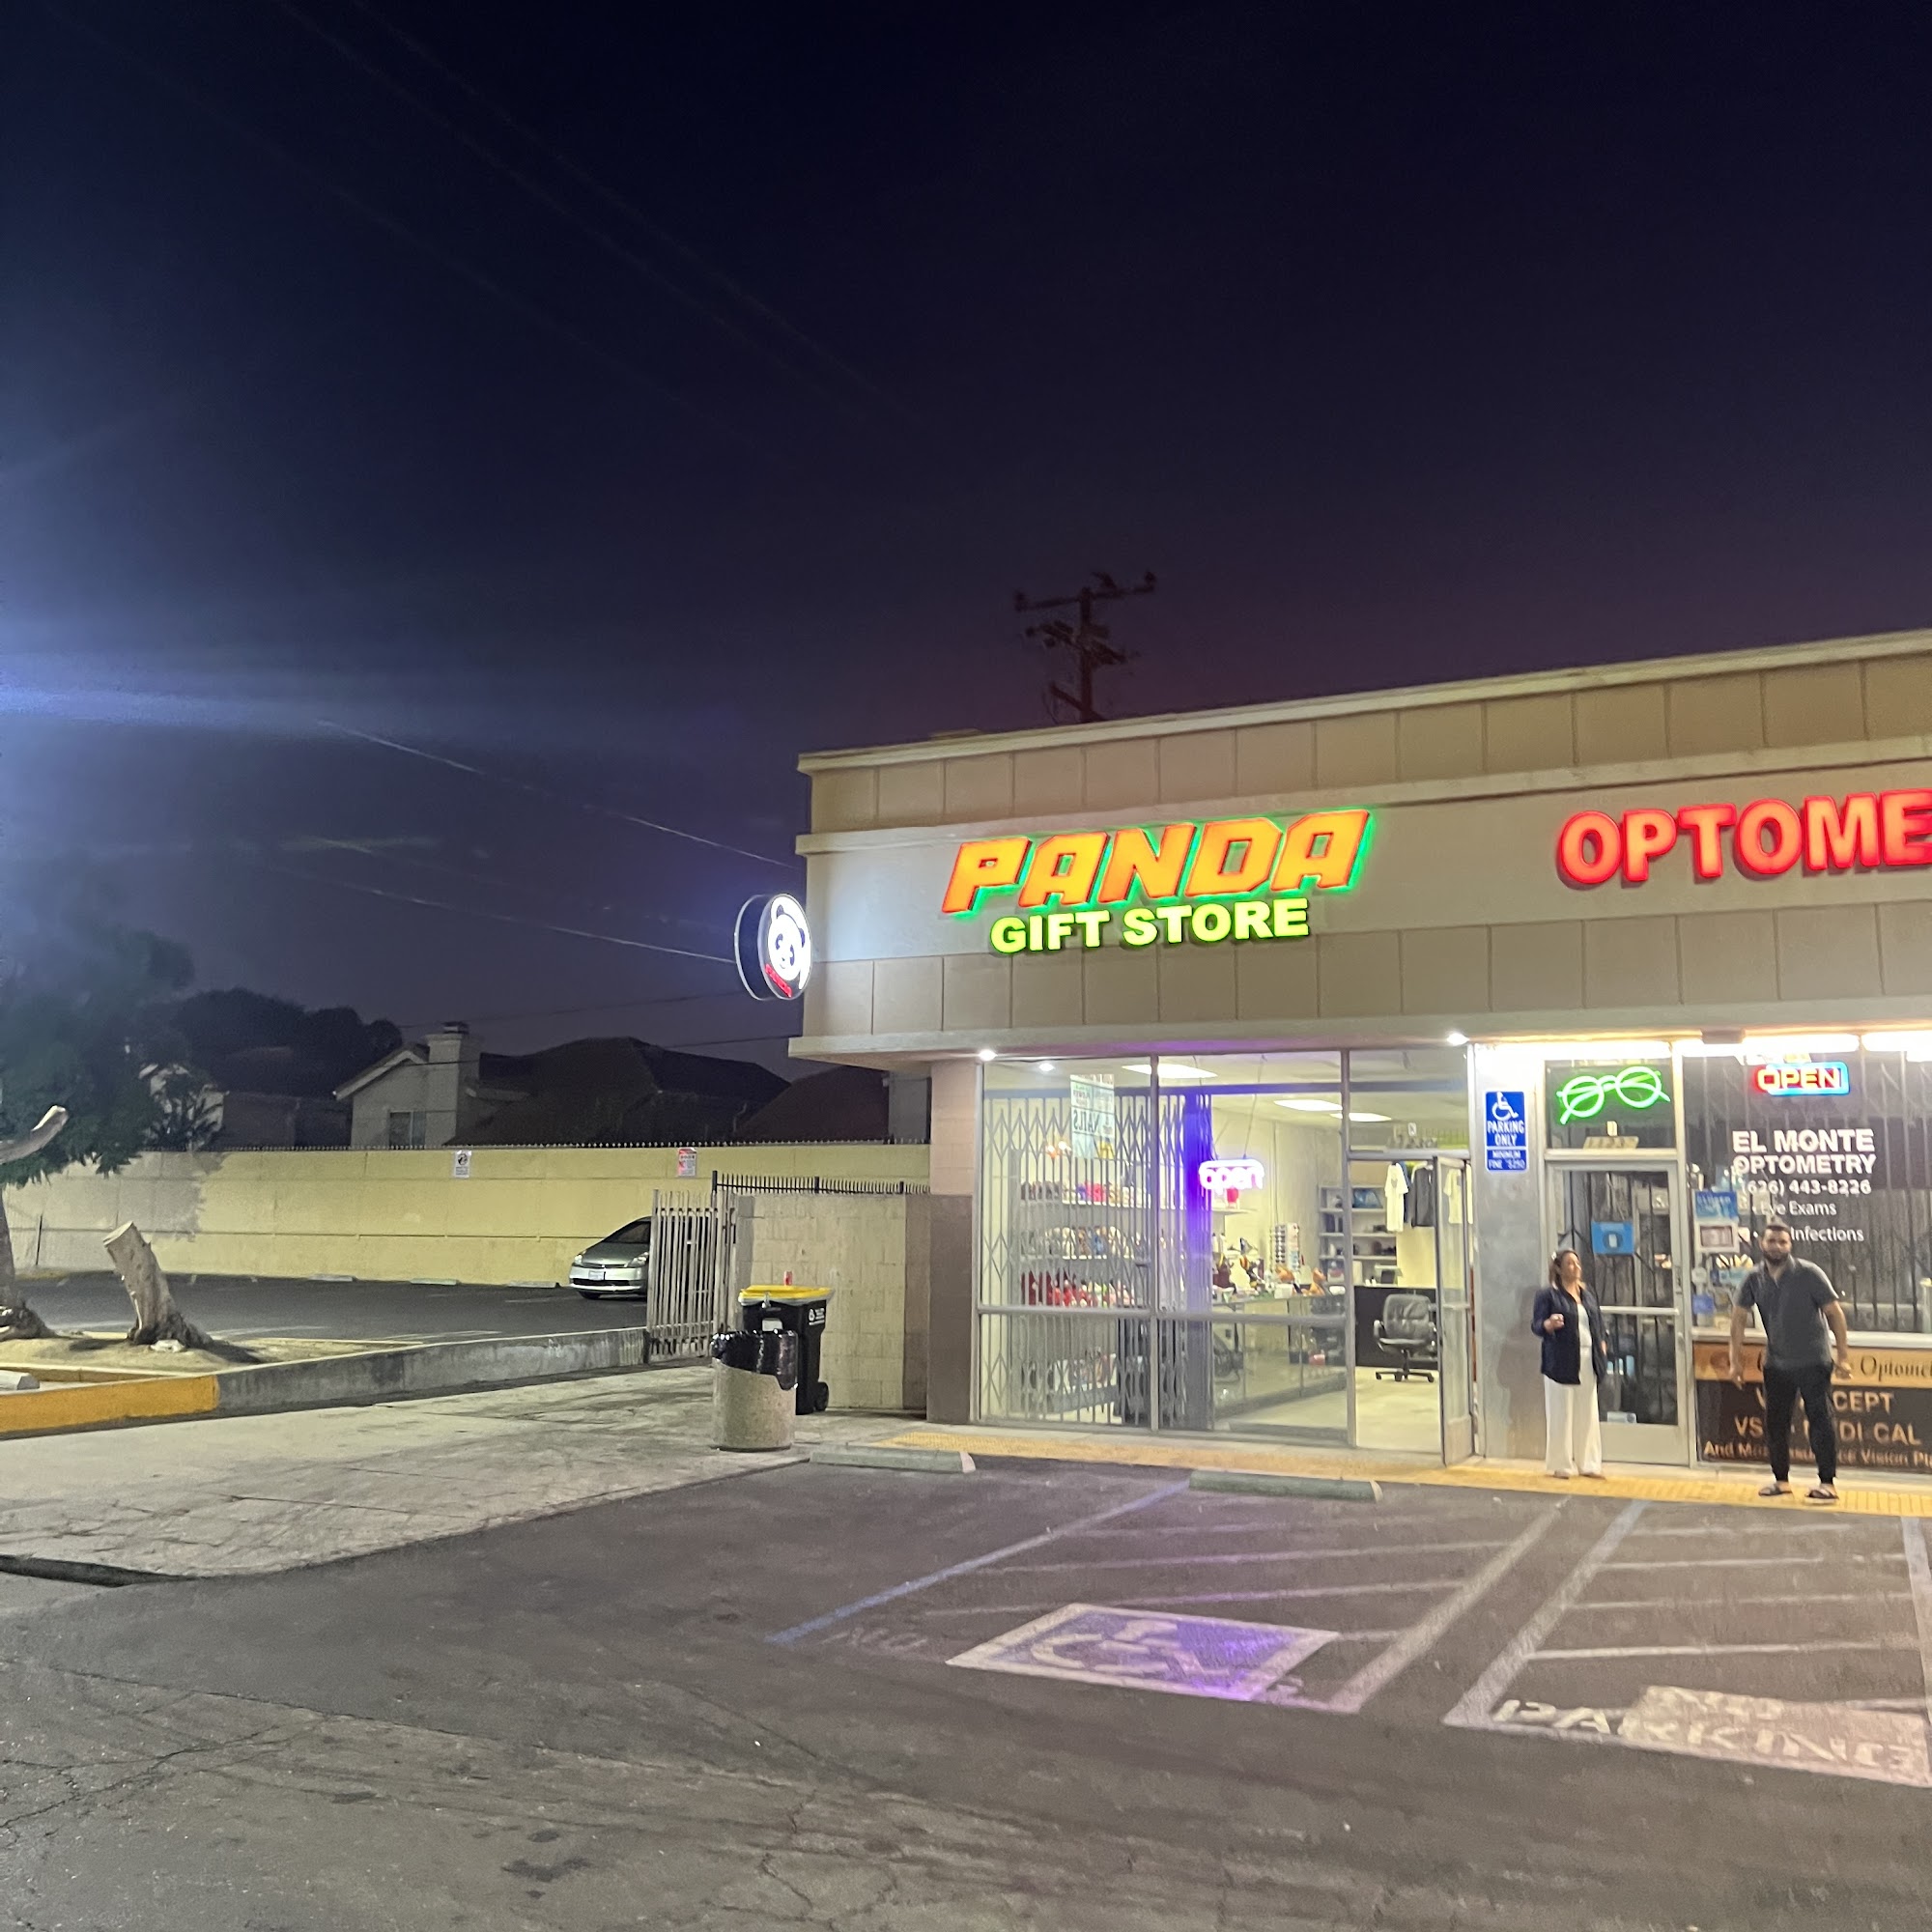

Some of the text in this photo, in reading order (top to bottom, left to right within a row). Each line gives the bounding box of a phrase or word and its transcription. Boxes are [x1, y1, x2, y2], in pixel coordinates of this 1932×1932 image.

[1558, 787, 1932, 885] OPTOME
[942, 809, 1370, 914] PANDA
[990, 897, 1310, 954] GIFT STORE
[1757, 1066, 1842, 1092] OPEN
[1488, 1121, 1524, 1134] PARKING
[1494, 1133, 1518, 1147] ONLY
[1732, 1128, 1876, 1153] EL MONTE
[1732, 1154, 1877, 1175] OPTOMETRY
[1742, 1179, 1873, 1197] (626) 443-8226
[1789, 1200, 1837, 1216] Exams
[1790, 1225, 1865, 1242] Infections
[1799, 1390, 1894, 1414] CEPT
[1734, 1416, 1764, 1438] VS
[1873, 1422, 1922, 1446] CAL
[1704, 1440, 1735, 1459] And
